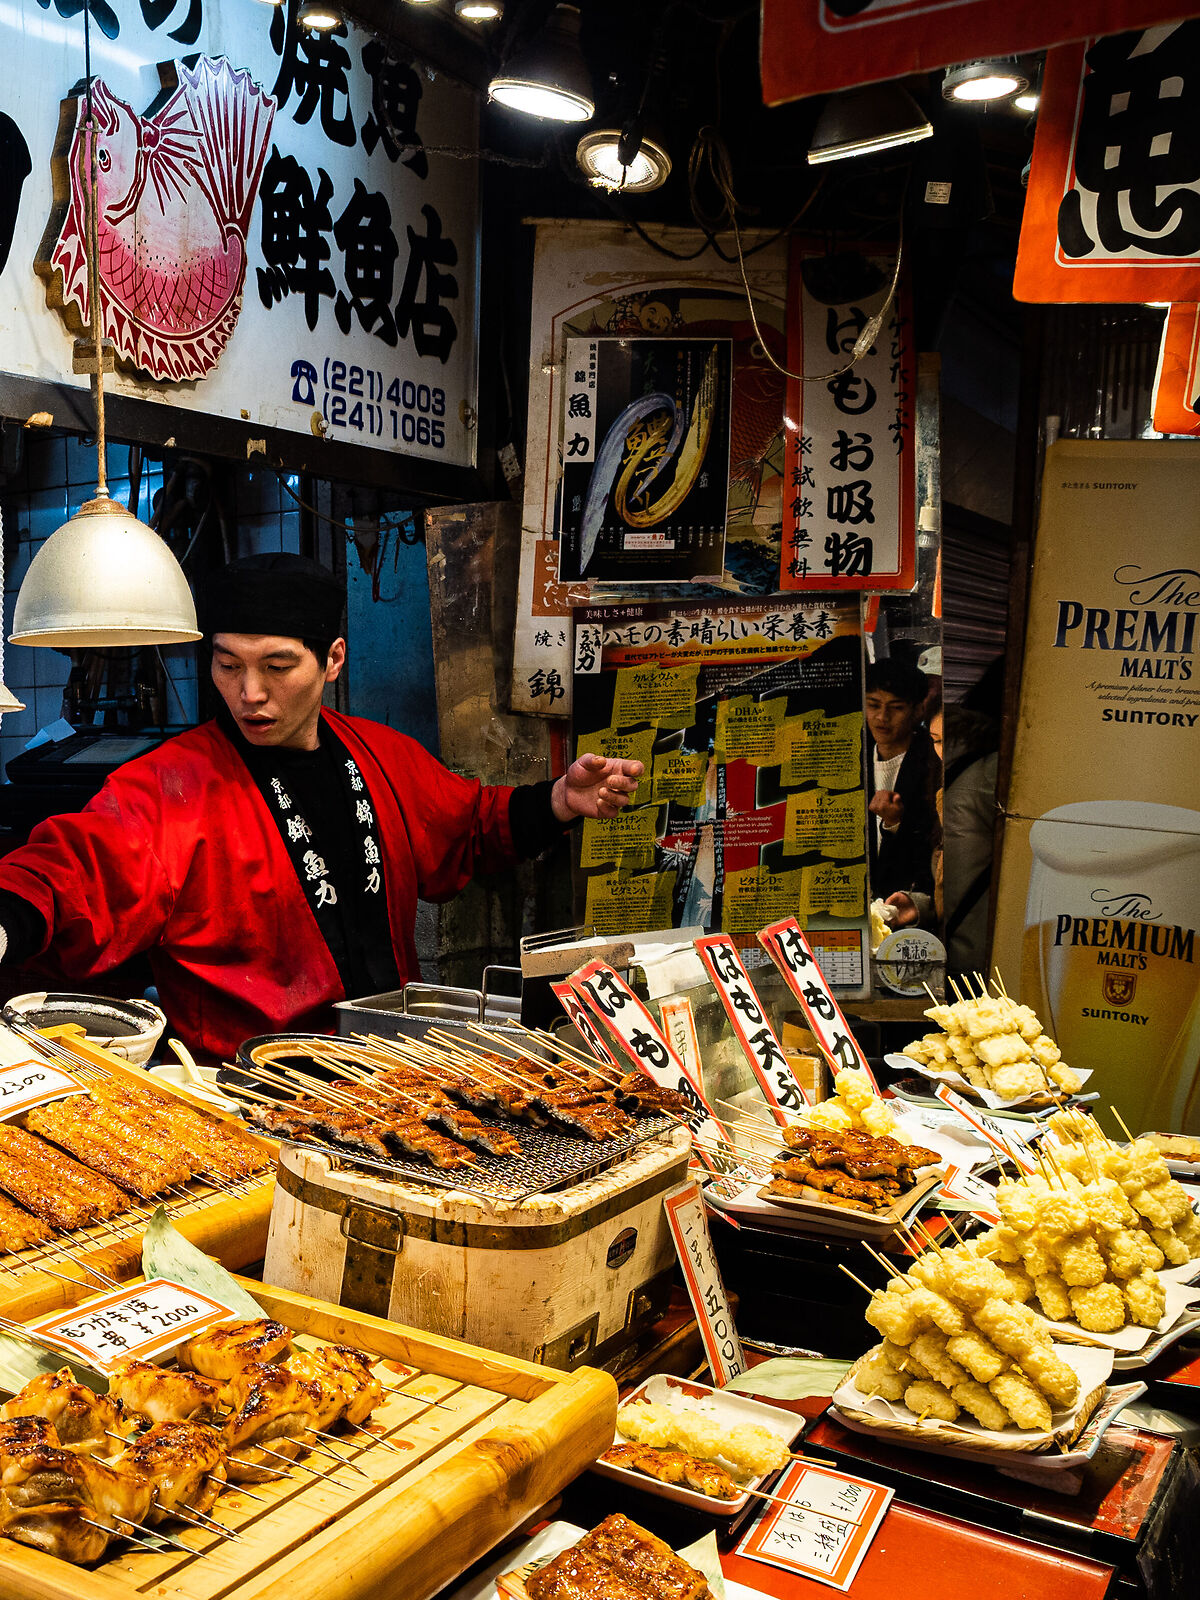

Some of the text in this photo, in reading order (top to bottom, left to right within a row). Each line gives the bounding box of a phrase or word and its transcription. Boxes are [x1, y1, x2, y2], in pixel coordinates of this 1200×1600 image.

[256, 143, 460, 366] 鮮魚店
[323, 357, 446, 417] (221)4003
[824, 307, 878, 577] はもお吸物
[1092, 482, 1138, 490] SUNTORY
[1113, 564, 1200, 607] The
[602, 610, 838, 648] ハモの素晴らしい栄養素
[1119, 655, 1193, 681] MALT'S
[1102, 708, 1199, 727] SUNTORY
[1090, 888, 1163, 921] The
[1053, 914, 1196, 963] PREMIUM
[1096, 951, 1148, 971] MALT'S
[705, 942, 806, 1118] はも天ぷ
[1081, 1007, 1150, 1026] SUNTORY
